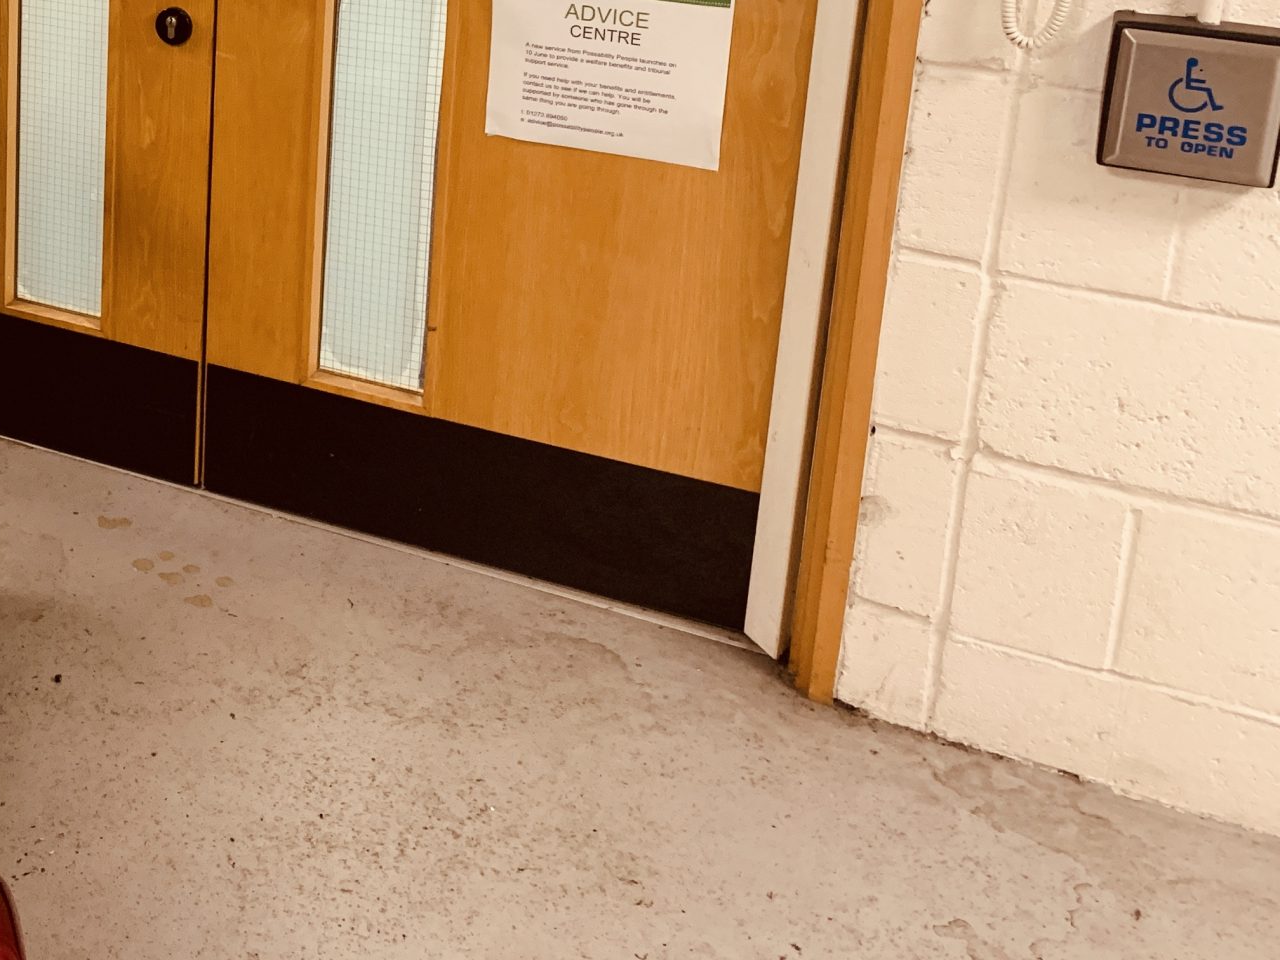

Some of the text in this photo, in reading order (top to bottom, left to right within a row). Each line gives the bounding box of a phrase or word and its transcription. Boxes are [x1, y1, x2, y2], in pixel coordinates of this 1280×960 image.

[564, 3, 651, 29] ADVICE
[570, 24, 642, 46] CENTRE
[1135, 113, 1248, 147] PRESS
[1144, 136, 1234, 159] TO OPEN
